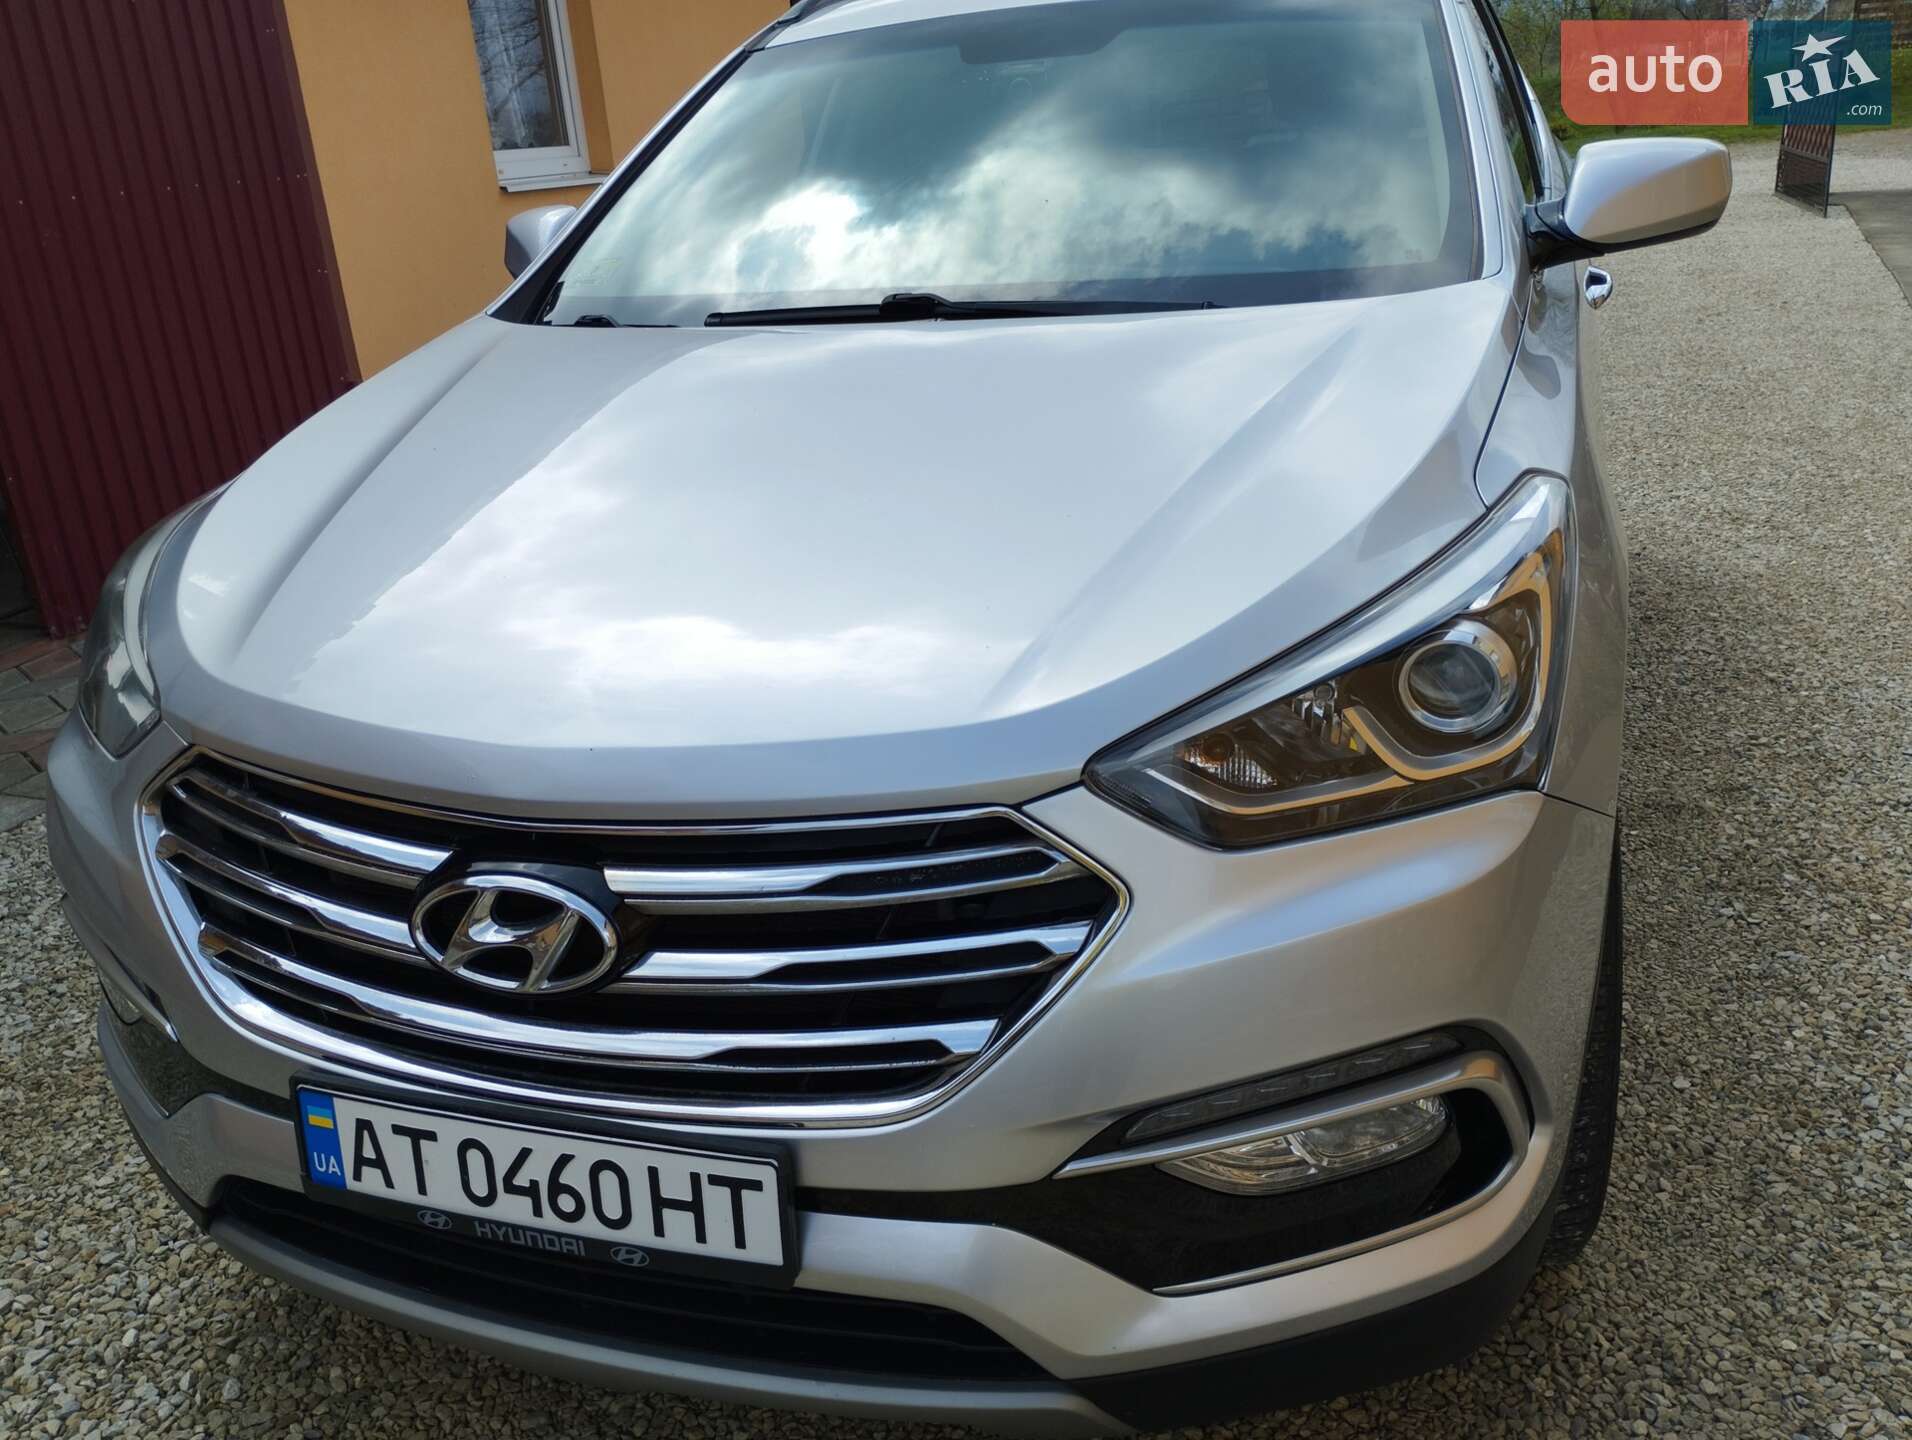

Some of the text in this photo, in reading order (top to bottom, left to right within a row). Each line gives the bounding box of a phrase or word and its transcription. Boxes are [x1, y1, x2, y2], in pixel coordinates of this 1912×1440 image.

[313, 1151, 342, 1177] UA
[352, 1117, 764, 1251] AT 0460 HT
[473, 1220, 586, 1257] HYUNDAI
